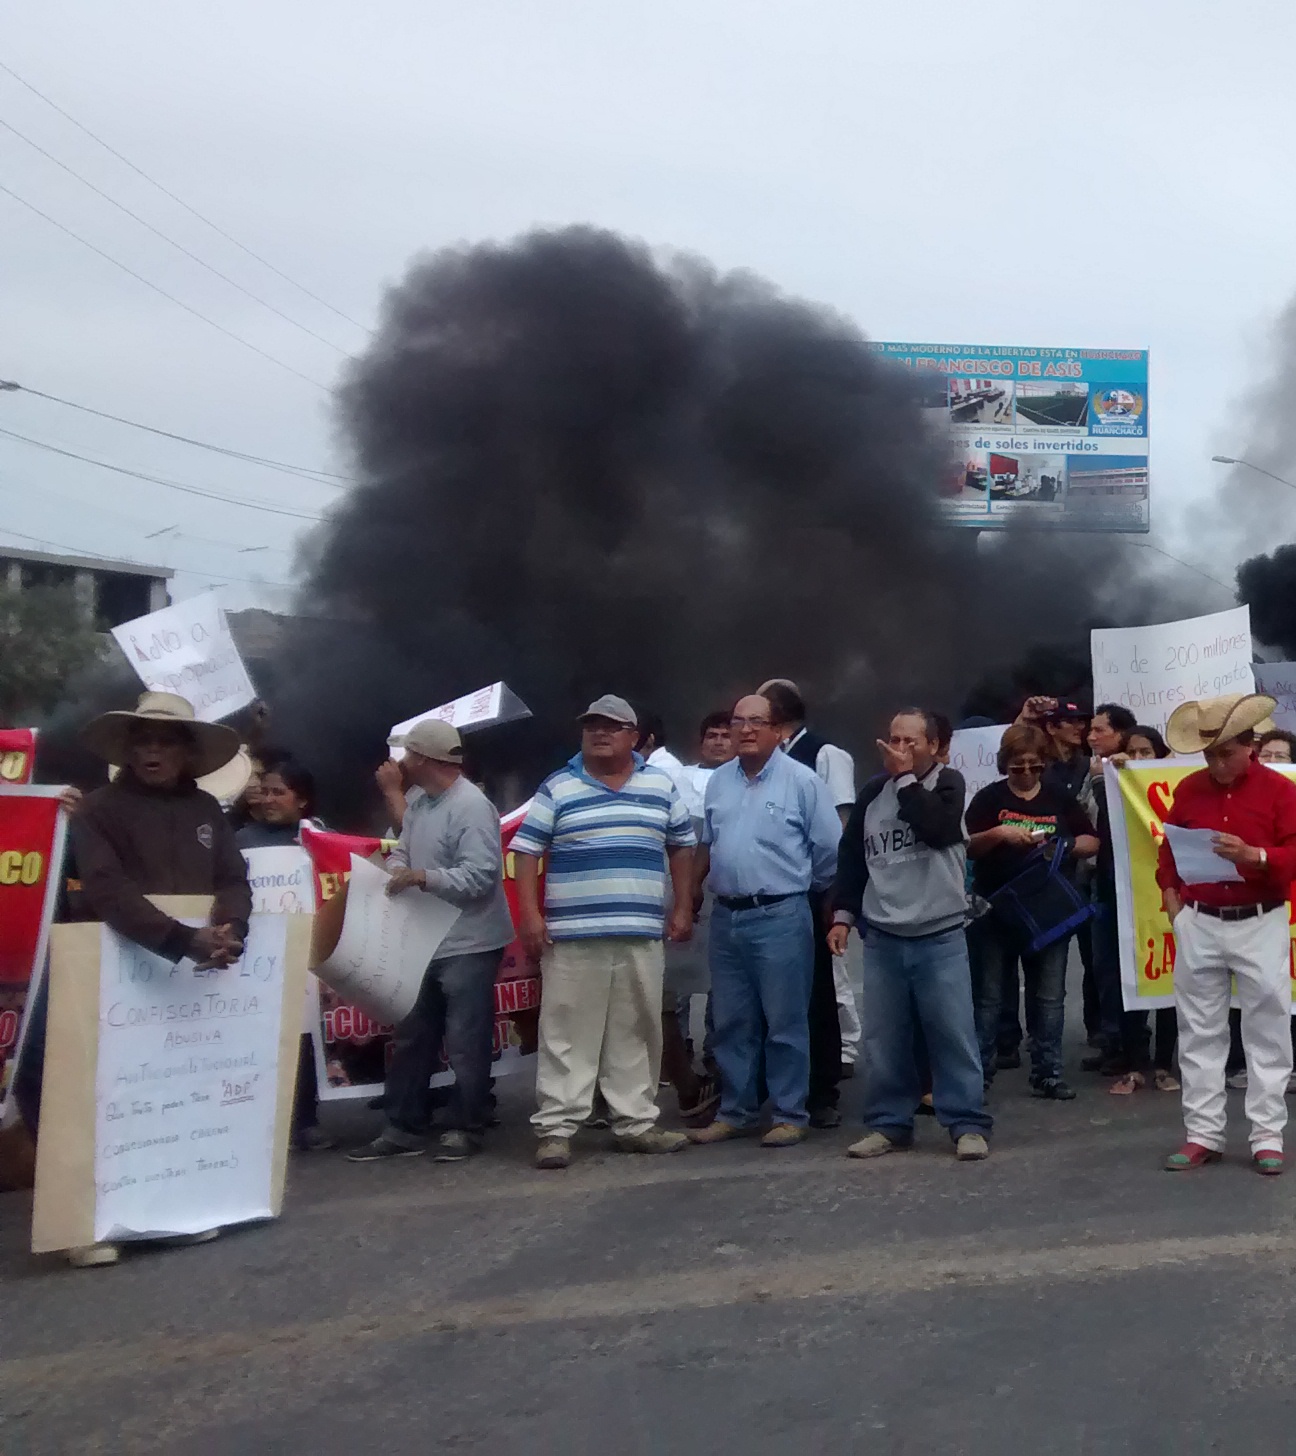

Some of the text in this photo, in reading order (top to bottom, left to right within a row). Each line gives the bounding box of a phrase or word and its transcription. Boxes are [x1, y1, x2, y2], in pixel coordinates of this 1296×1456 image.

[910, 345, 960, 354] MODERNO
[963, 346, 975, 354] DE
[978, 347, 991, 355] LA
[993, 347, 1037, 356] LIBERTAD
[1065, 349, 1078, 358] EN
[1018, 360, 1041, 376] DE
[974, 437, 991, 449] de
[995, 438, 1029, 450] soles
[1033, 439, 1099, 452] invertidos
[1130, 644, 1148, 674] de
[1164, 642, 1199, 671] 200
[1193, 673, 1208, 697] de
